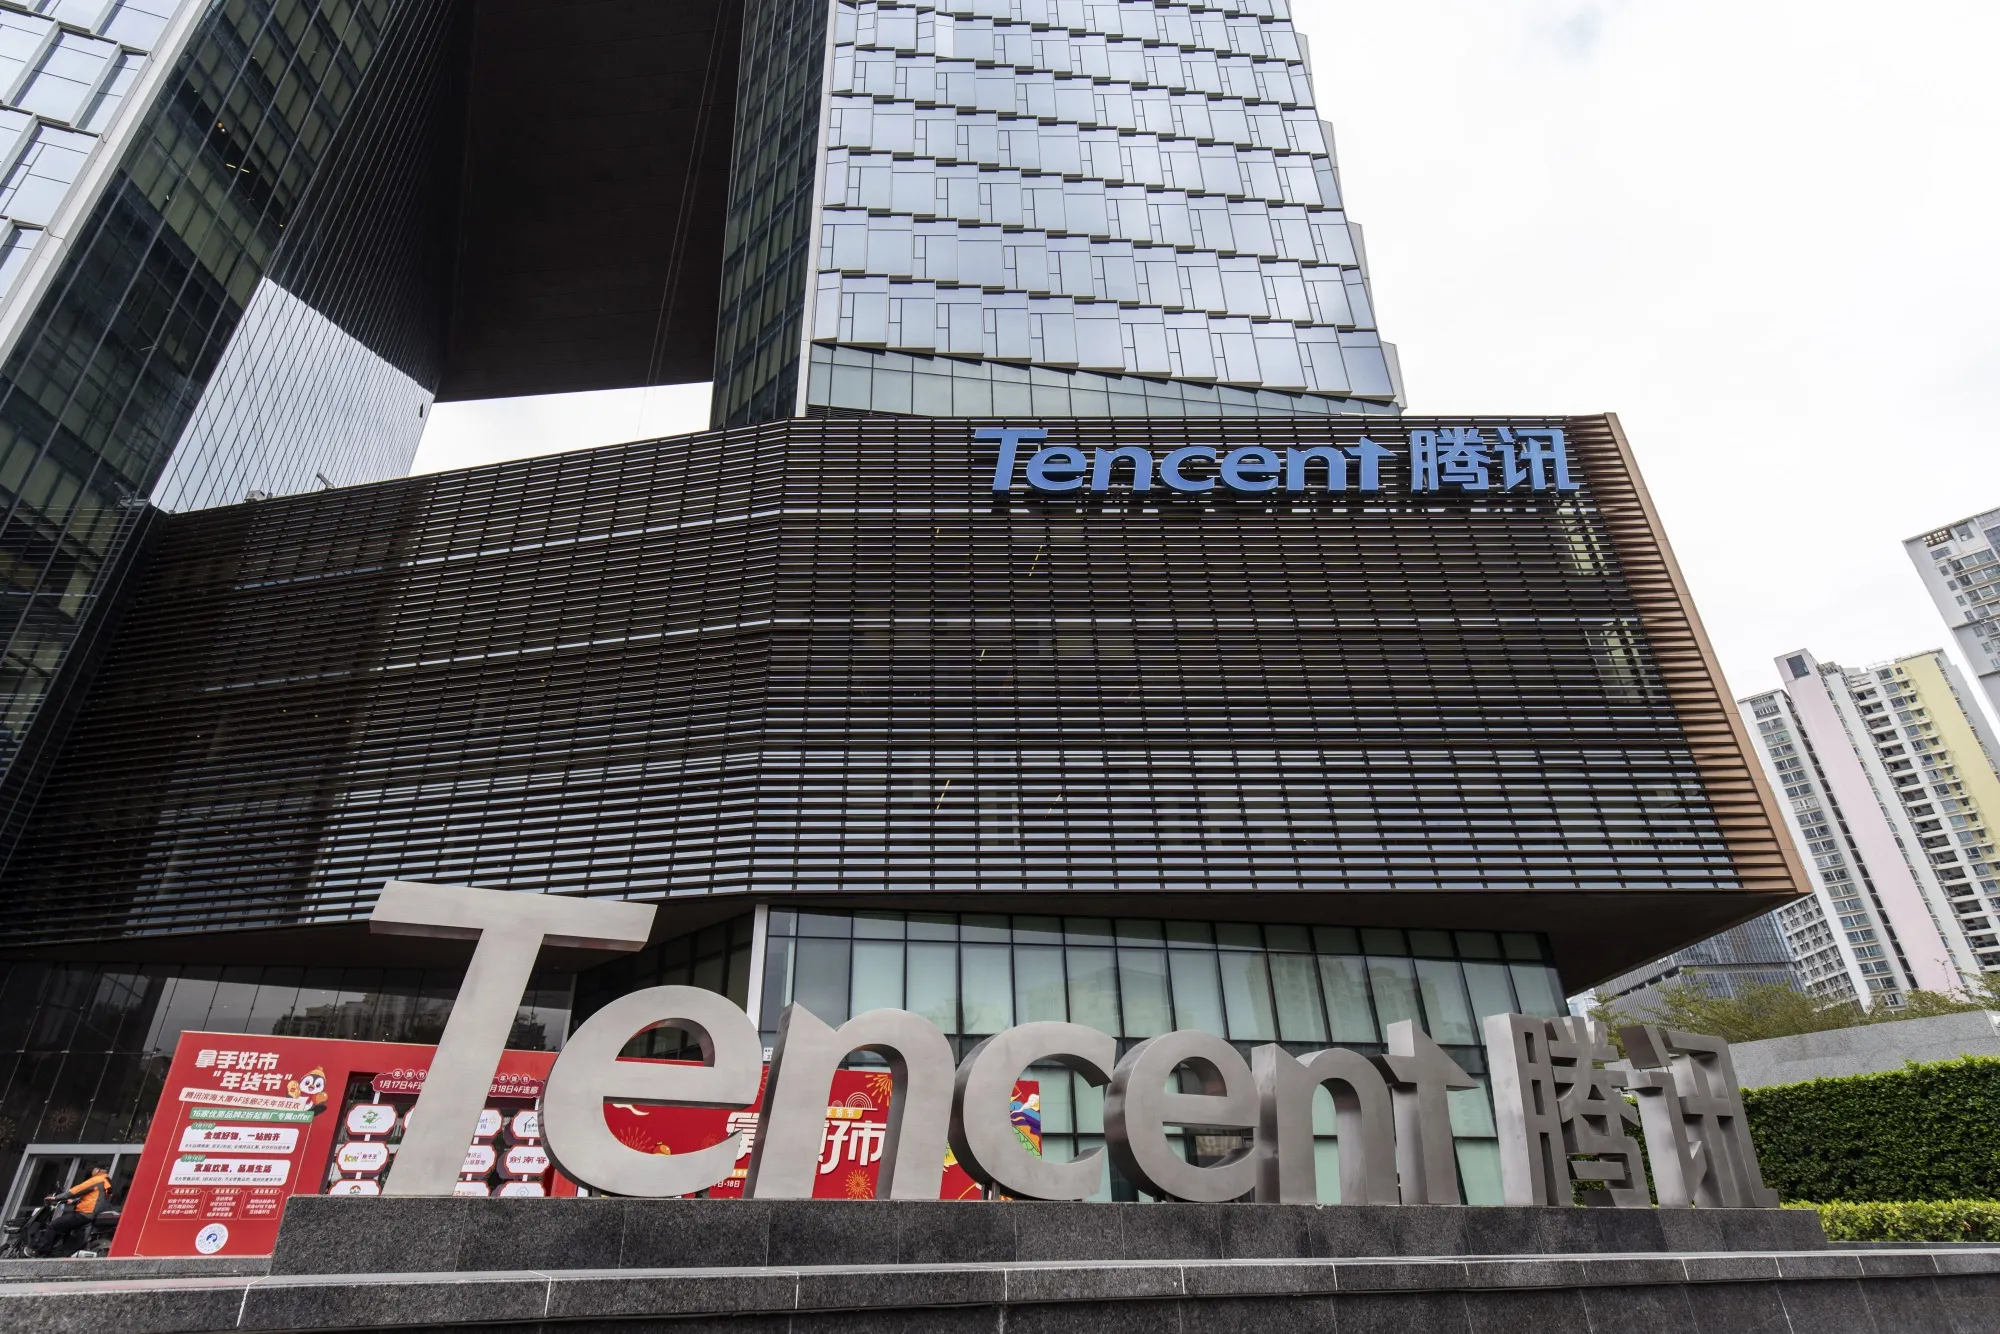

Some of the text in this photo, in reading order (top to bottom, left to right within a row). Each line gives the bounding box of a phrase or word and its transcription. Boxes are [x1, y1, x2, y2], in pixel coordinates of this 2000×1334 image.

[973, 427, 1581, 494] Tencent 腾讯
[194, 1049, 280, 1070] 拿手好市
[369, 879, 1781, 1209] Tencent 腾讯
